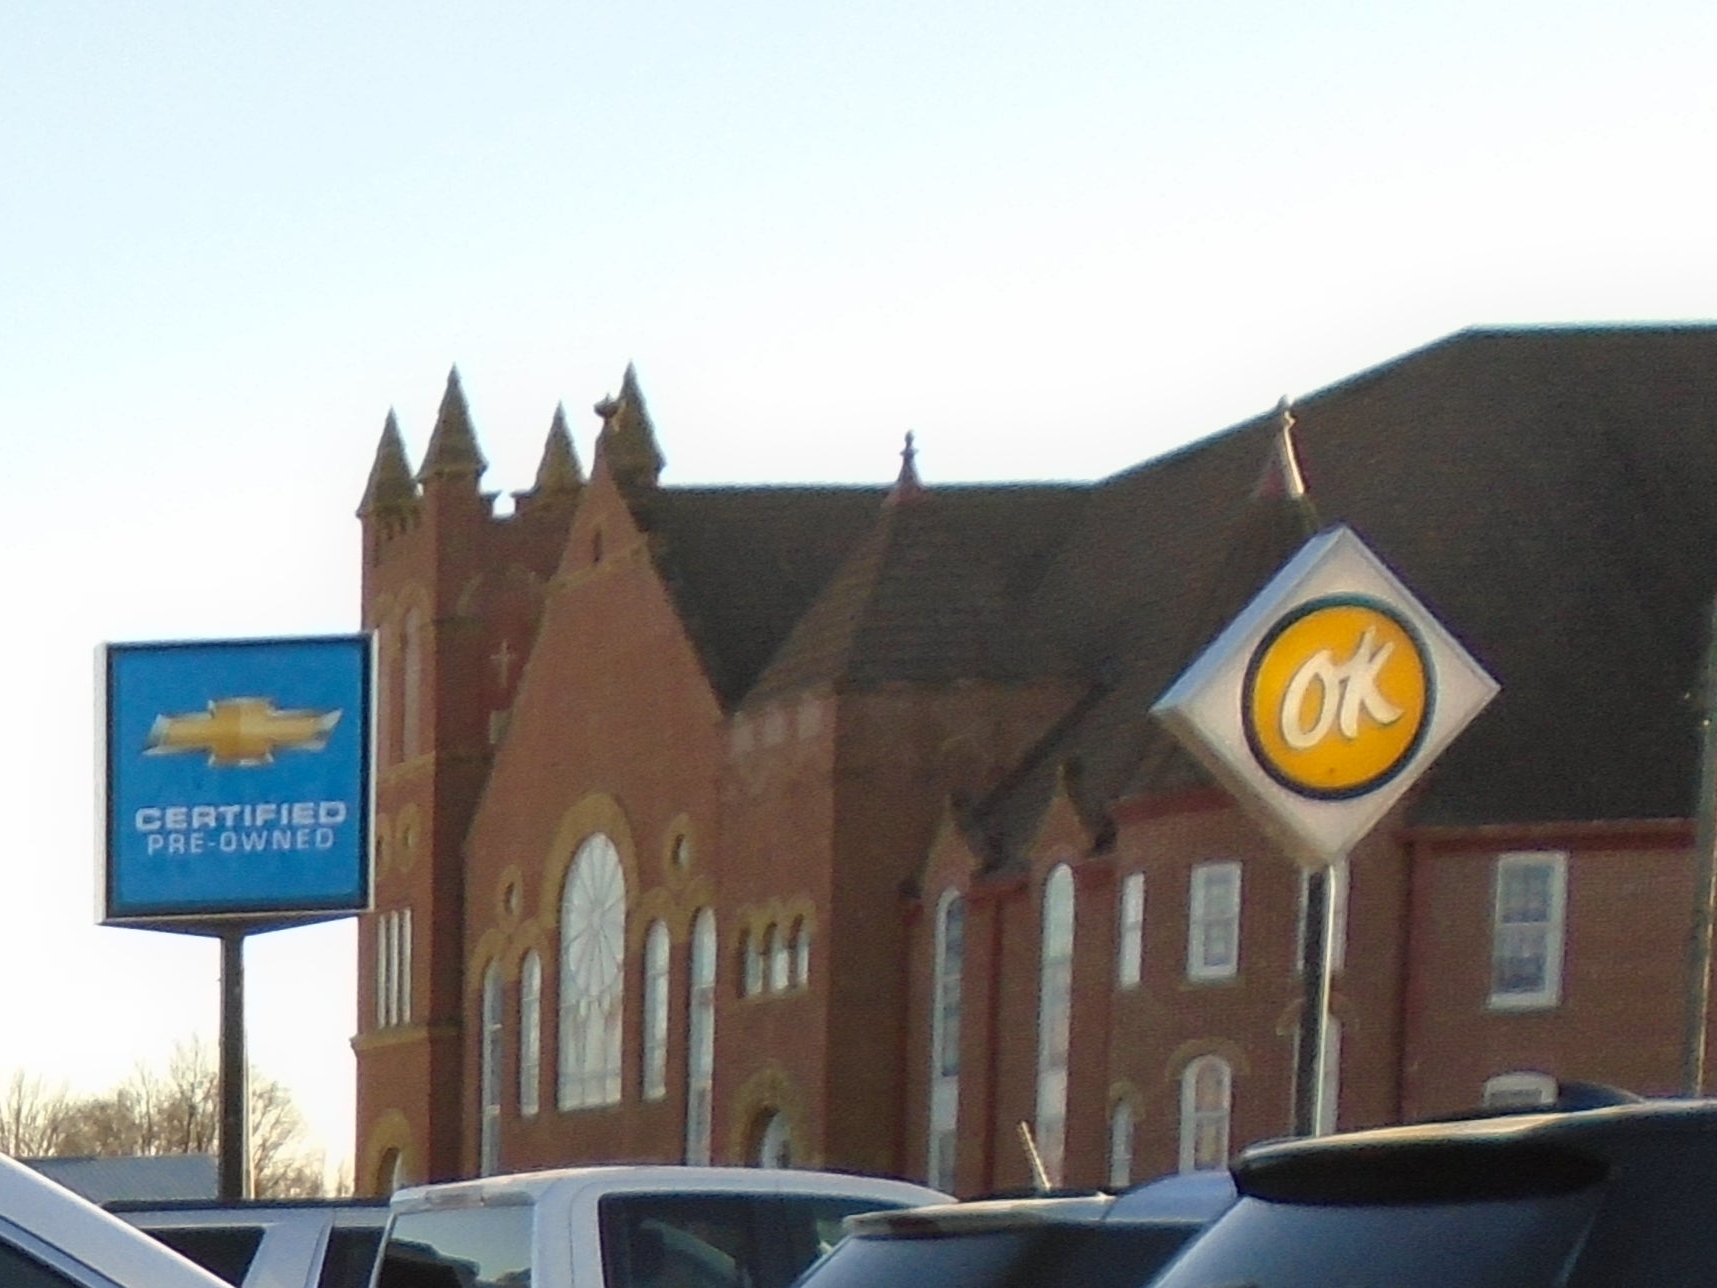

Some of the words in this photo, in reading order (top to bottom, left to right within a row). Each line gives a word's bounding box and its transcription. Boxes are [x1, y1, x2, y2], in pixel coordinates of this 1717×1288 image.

[1281, 626, 1404, 750] OK
[134, 801, 347, 832] CERTIFIED
[147, 827, 335, 856] PRE-OWNED
